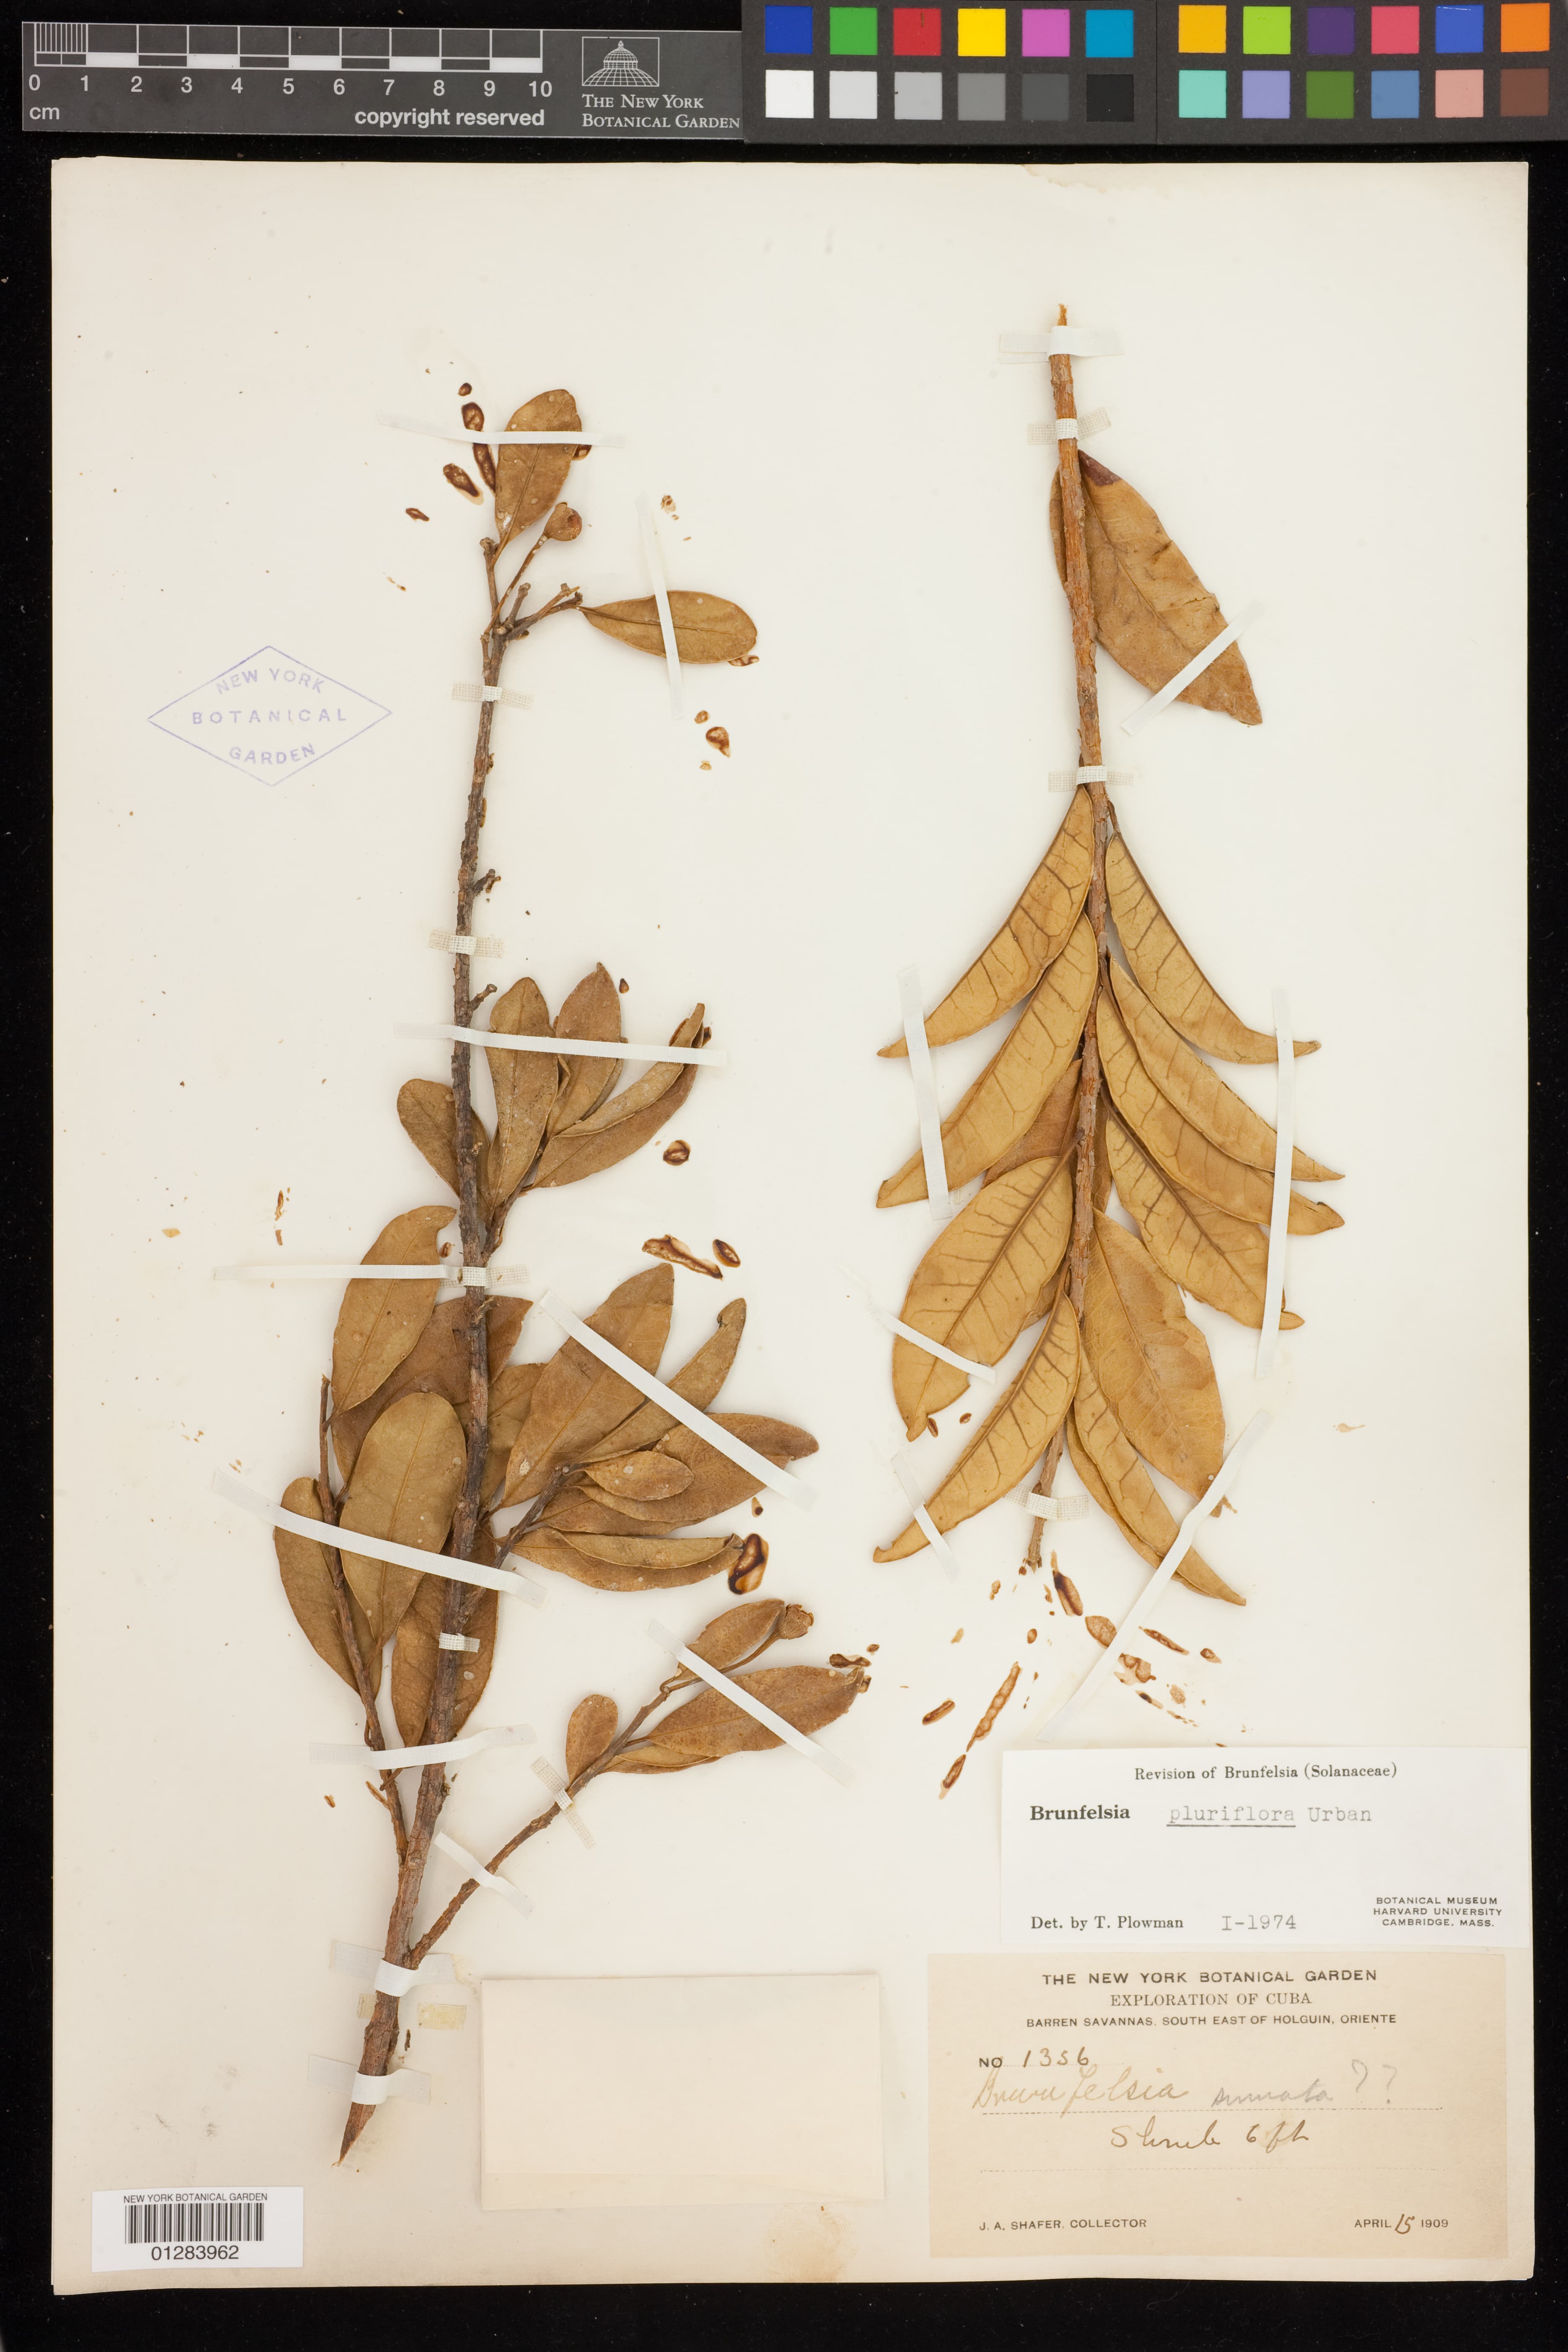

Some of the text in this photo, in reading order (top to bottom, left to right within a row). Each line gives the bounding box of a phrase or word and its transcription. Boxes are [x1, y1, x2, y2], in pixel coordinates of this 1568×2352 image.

[28, 74, 552, 97] 0 1 2 3 4 5 6 7 8 9 10
[29, 107, 59, 120] cm
[355, 108, 544, 129] copyright reserved
[215, 668, 325, 694] NEW YORK
[192, 708, 347, 725] BOTANICAL
[229, 743, 315, 765] GARDEN
[1135, 1762, 1397, 1780] Revision of Brunfelsia (Solanaceae)
[1030, 1804, 1372, 1823] Brunfelsia pluriflora Urban
[1434, 1908, 1502, 1916] UNIVERSITY
[1031, 1916, 1184, 1931] Det. by T. Plowman
[1222, 1915, 1296, 1931] I-1974
[1042, 1970, 1376, 1985] THE NEW YORK BOTANICAL GARDEN
[1111, 1992, 1312, 2006] EXPLORATION OF CUBA
[1027, 2018, 1077, 2027] BARREN
[1163, 2017, 1206, 2025] SOUTH
[1213, 2016, 1246, 2025] EAST
[1250, 2016, 1267, 2024] OF
[1274, 2015, 1334, 2024] HOLGUIN,
[1340, 2014, 1396, 2024] ORIENTE
[1022, 2046, 1089, 2068] 1356
[1246, 2123, 1260, 2143] 6
[124, 2195, 145, 2203] NEW
[147, 2194, 173, 2202] YORK
[176, 2193, 227, 2202] BOTANICAL
[979, 2222, 989, 2231] J.
[994, 2221, 1005, 2231] A.
[1070, 2219, 1146, 2228] COLLECTOR
[1354, 2214, 1448, 2234] APRIL 15 1909
[151, 2245, 239, 2261] 01283962
